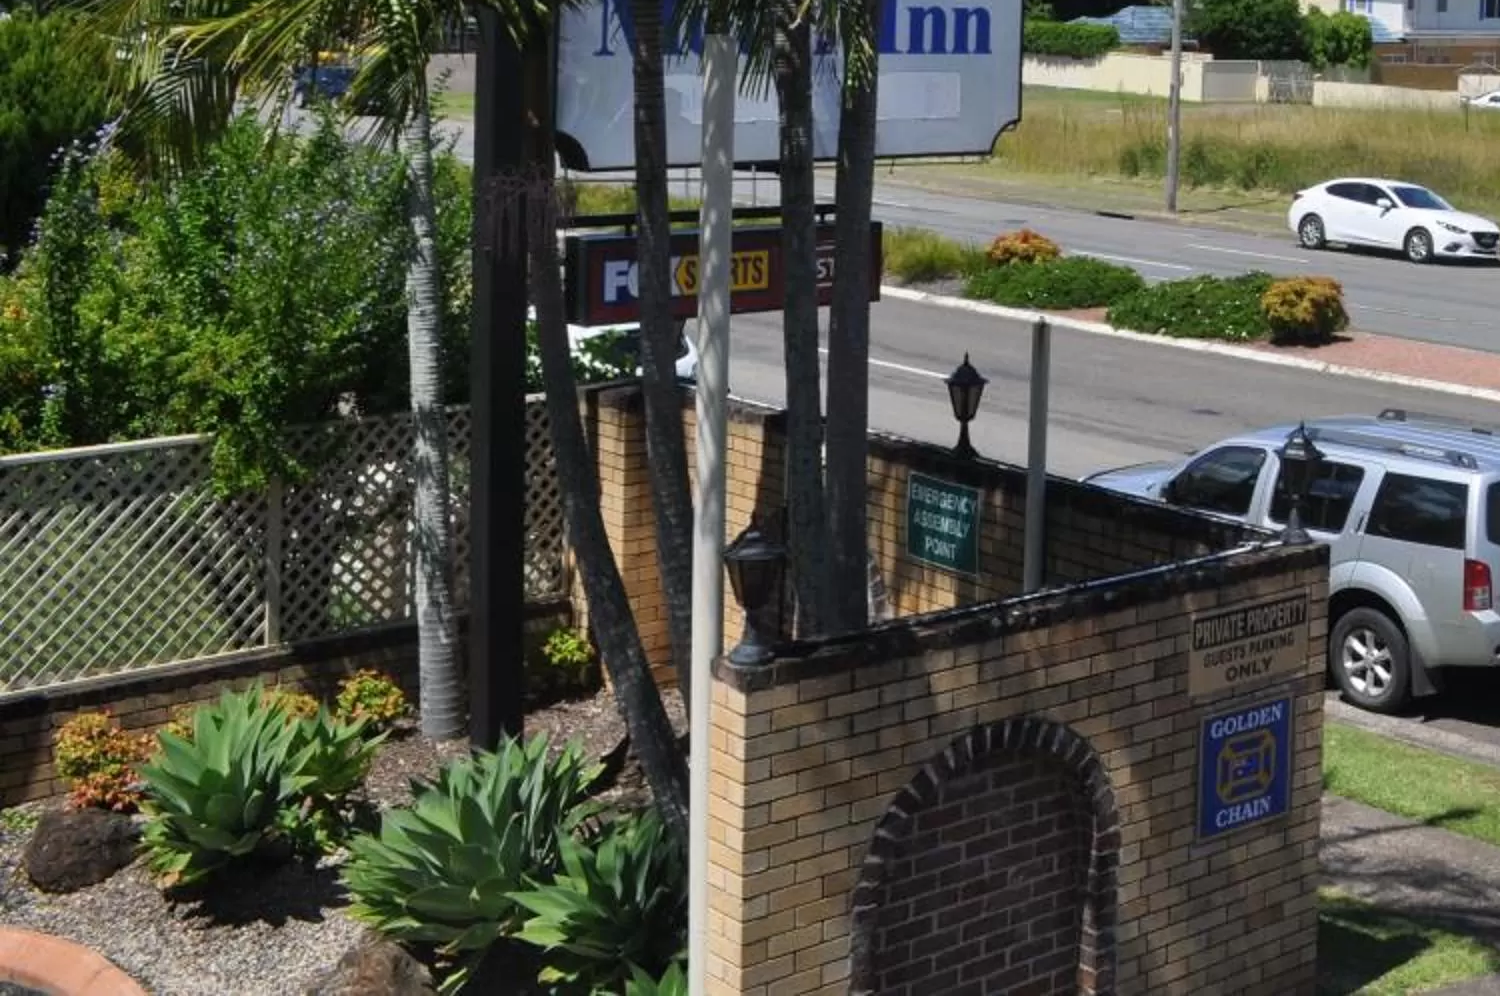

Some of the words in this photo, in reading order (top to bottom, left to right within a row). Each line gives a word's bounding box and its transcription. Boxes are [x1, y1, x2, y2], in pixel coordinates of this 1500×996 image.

[685, 255, 764, 289] SRTS
[911, 483, 976, 515] EMERGENCY
[913, 508, 971, 538] ASSEMBLY
[925, 535, 957, 561] POINT
[1194, 611, 1246, 649] PRIVATE
[1247, 601, 1305, 636] PROPERTY
[1203, 645, 1246, 669] GUESTS
[1249, 630, 1295, 653] PARKING
[1225, 656, 1272, 682] ONLY
[1210, 702, 1283, 740] GOLDEN
[1215, 795, 1272, 828] CHAIN
